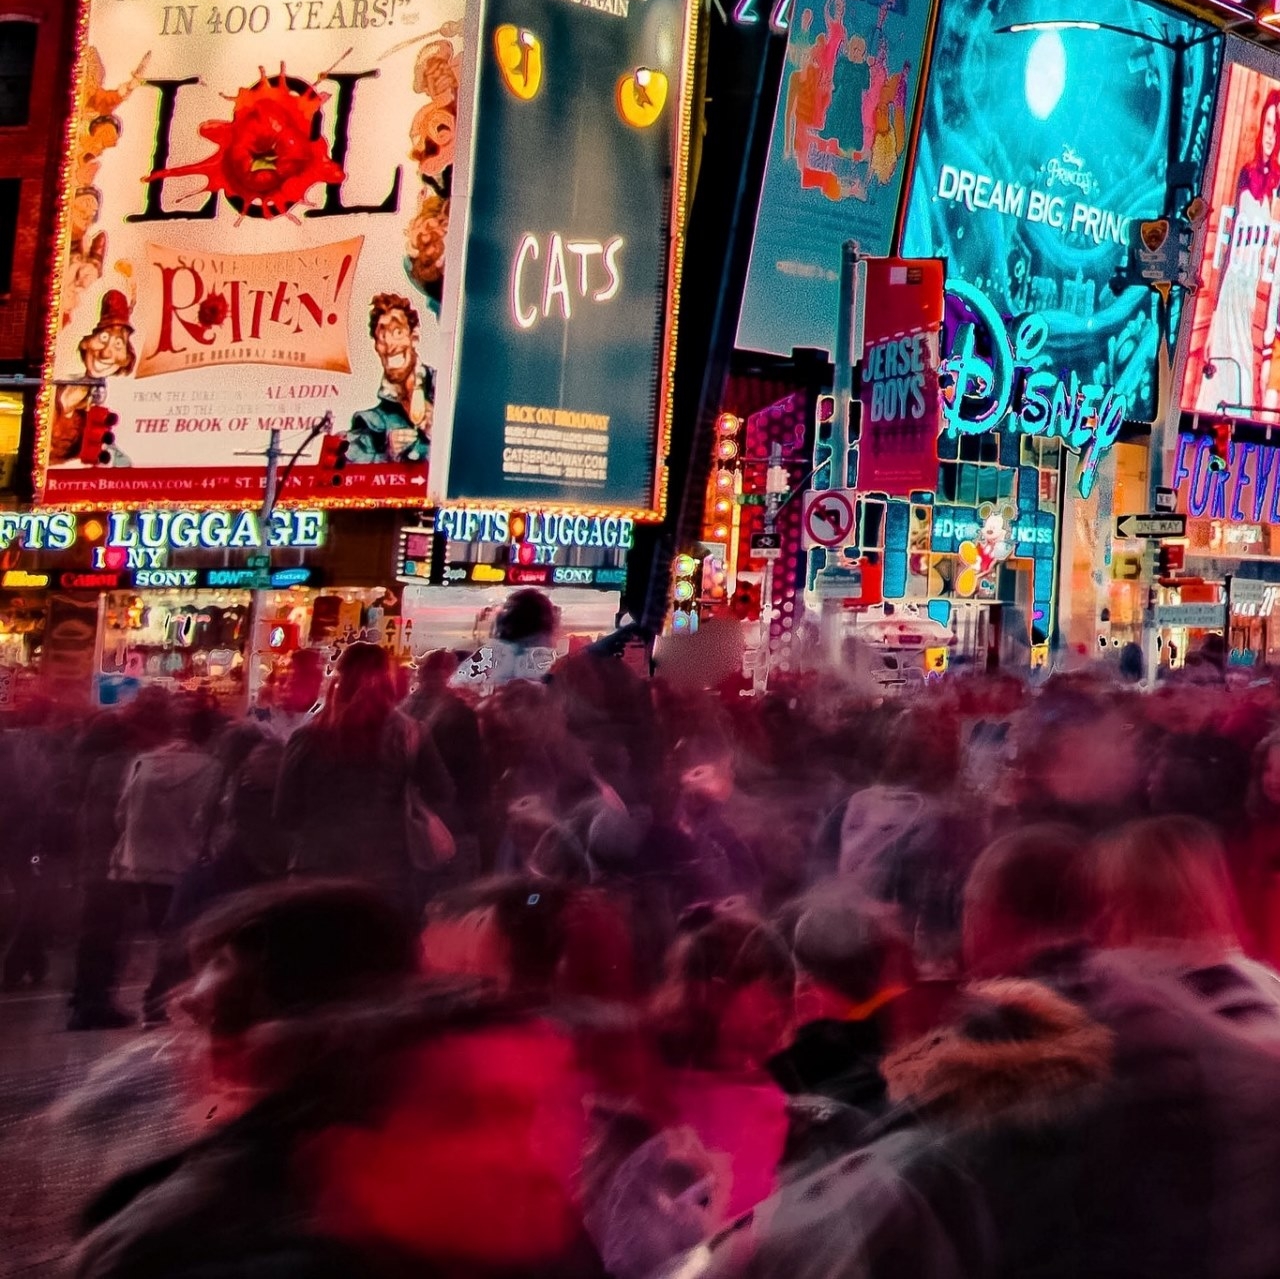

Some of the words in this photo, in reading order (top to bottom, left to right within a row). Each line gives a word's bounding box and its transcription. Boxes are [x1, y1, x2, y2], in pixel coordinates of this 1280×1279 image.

[159, 5, 199, 36] IN
[206, 4, 270, 34] 400
[938, 164, 1026, 218] DREAM
[1027, 189, 1067, 235] BIG,
[511, 231, 623, 328] CATS
[265, 384, 340, 400] ALADDIN
[871, 372, 925, 421] BOYS
[135, 419, 169, 433] THE
[174, 418, 222, 433] BOOK
[228, 418, 250, 431] OF
[536, 407, 553, 426] ON
[502, 447, 608, 469] CATSBROADWAY.COM
[372, 473, 406, 487] AVES
[108, 510, 324, 548] LUGGAGE
[437, 509, 509, 543] GIFTS
[525, 511, 634, 548] LUGGAGE
[1137, 520, 1158, 531] ONE
[1160, 521, 1180, 531] WAY
[126, 547, 165, 568] NY
[534, 545, 558, 565] NY
[136, 571, 198, 587] SONY
[554, 568, 593, 583] SONY
